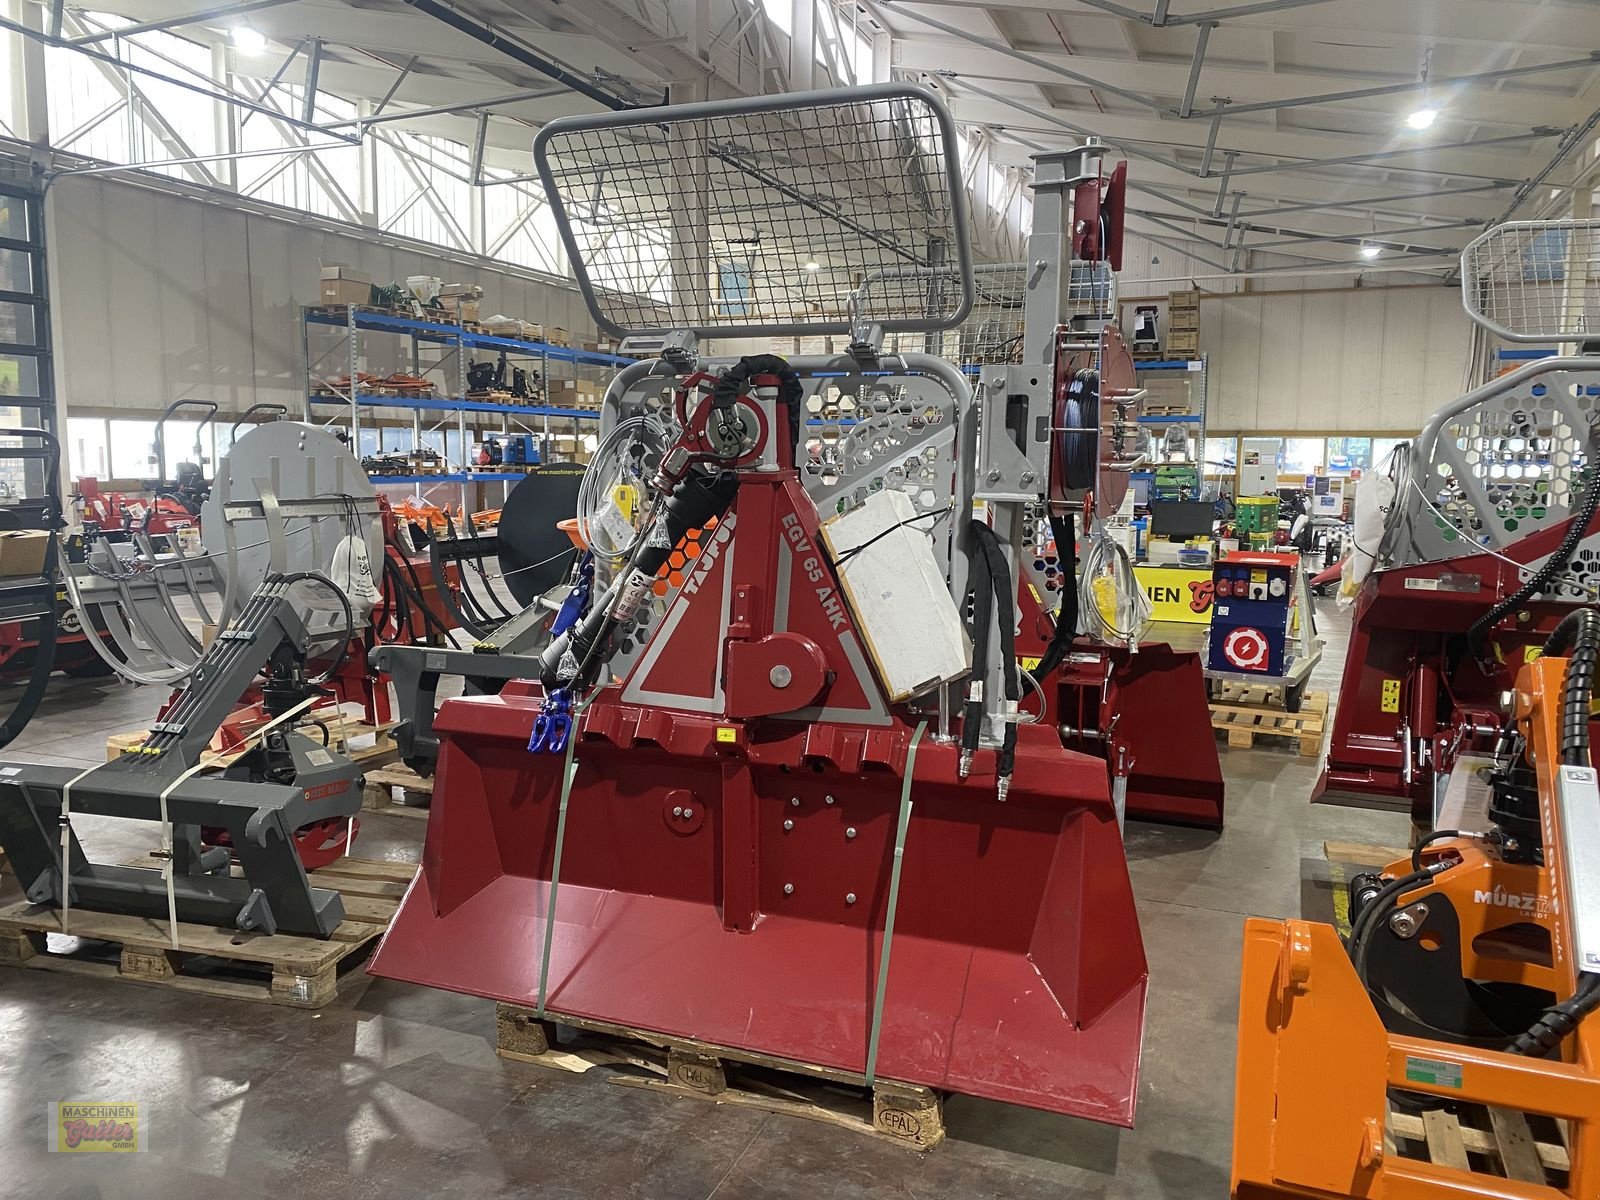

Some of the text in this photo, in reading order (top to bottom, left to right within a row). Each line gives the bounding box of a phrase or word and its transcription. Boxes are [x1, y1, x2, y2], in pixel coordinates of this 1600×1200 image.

[683, 511, 737, 595] TAJFUN
[782, 512, 847, 631] EGV 65 AHK
[885, 1112, 914, 1133] EPAL
